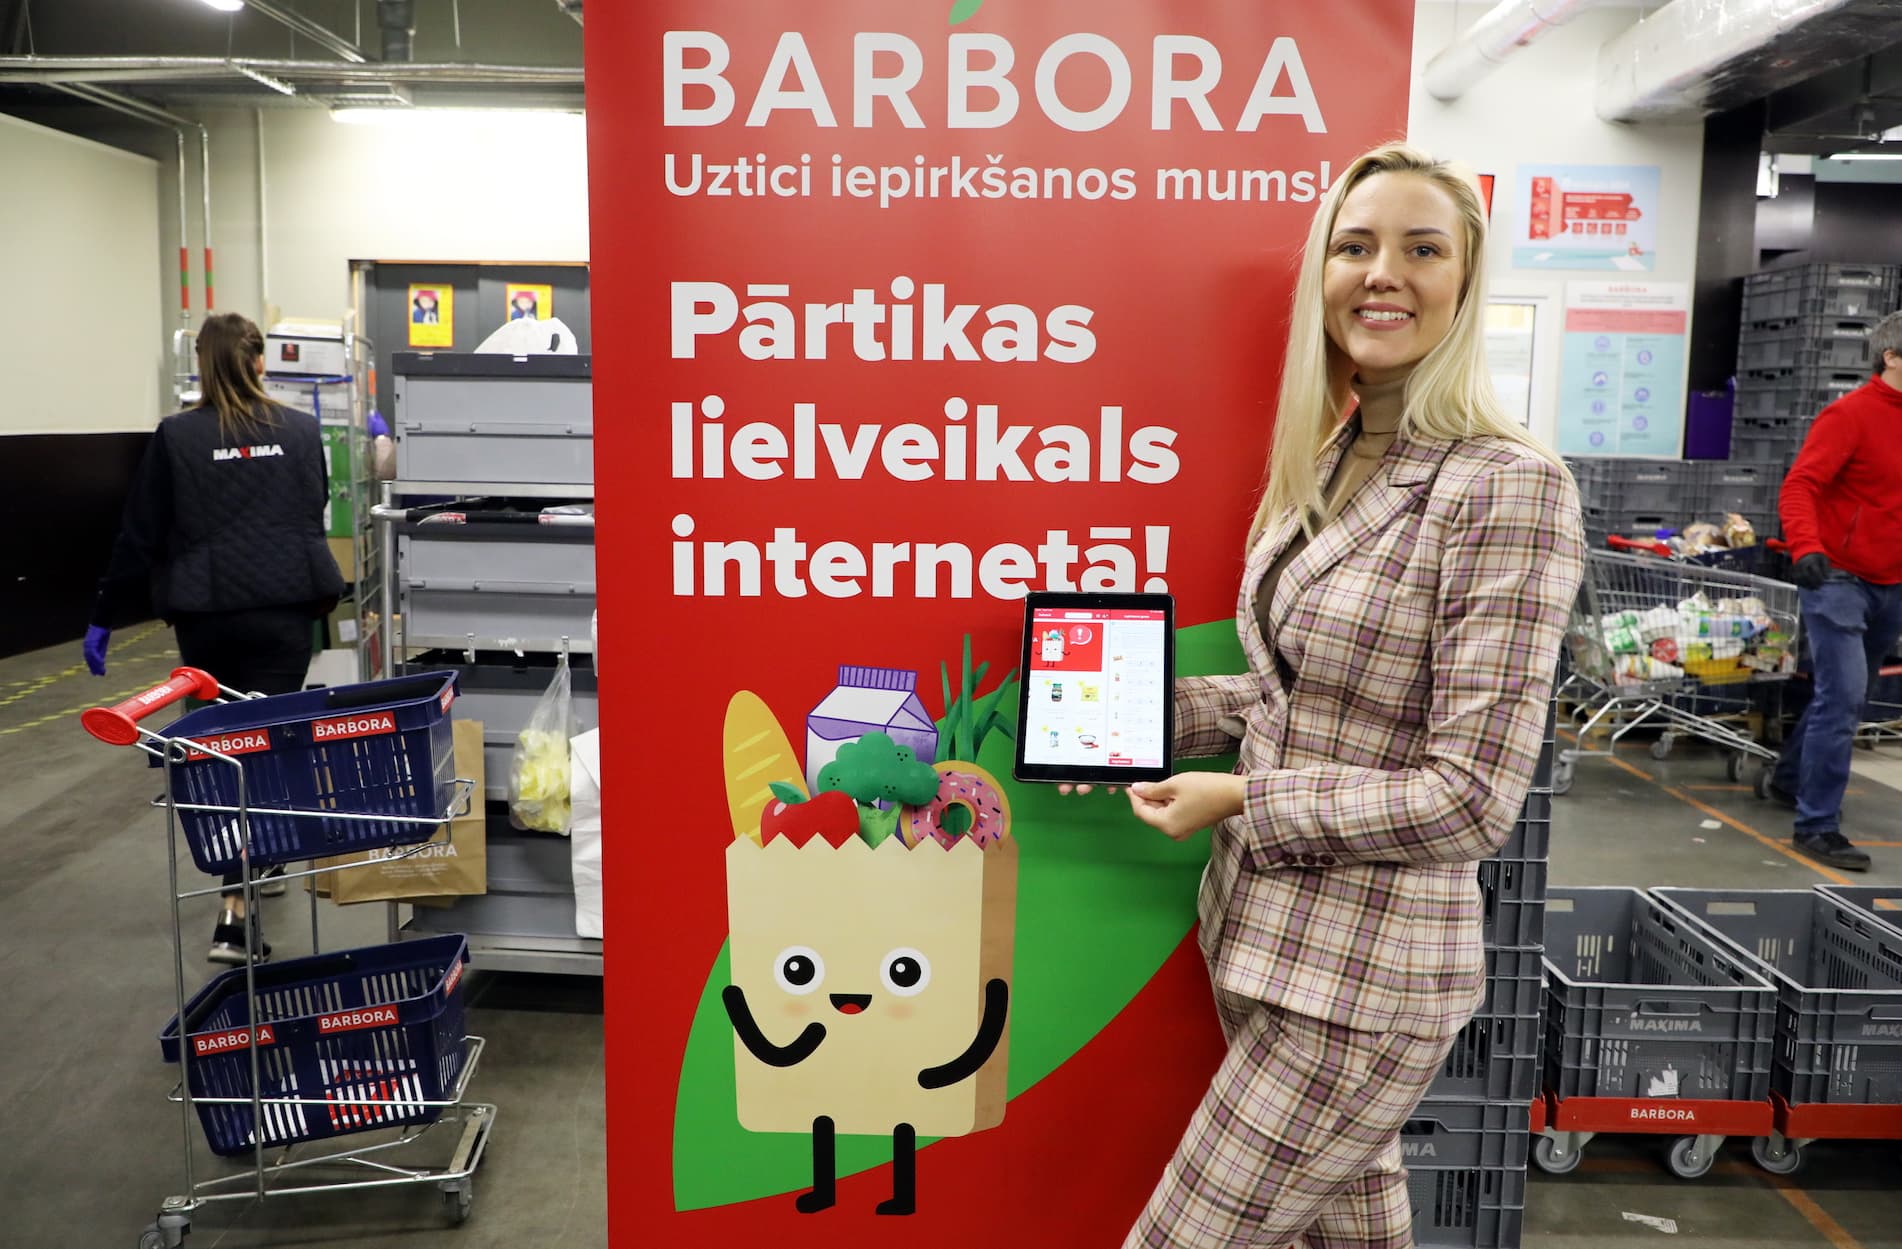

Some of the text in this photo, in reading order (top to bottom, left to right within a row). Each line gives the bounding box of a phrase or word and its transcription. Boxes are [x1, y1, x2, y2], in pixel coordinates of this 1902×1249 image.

[662, 31, 1328, 133] BARBORA
[664, 153, 1331, 208] Uztici iepirkšanos mums!
[671, 275, 1097, 364] Pārtikas
[671, 394, 1181, 484] lielveikals
[212, 443, 285, 461] MAXIMA
[671, 513, 1171, 600] internetā!
[314, 717, 393, 737] BARBORA
[321, 1009, 396, 1030] BARBORA
[1629, 1018, 1702, 1033] MAXIMA
[197, 1029, 272, 1051] BARBOA
[1630, 1107, 1696, 1121] BARBORA
